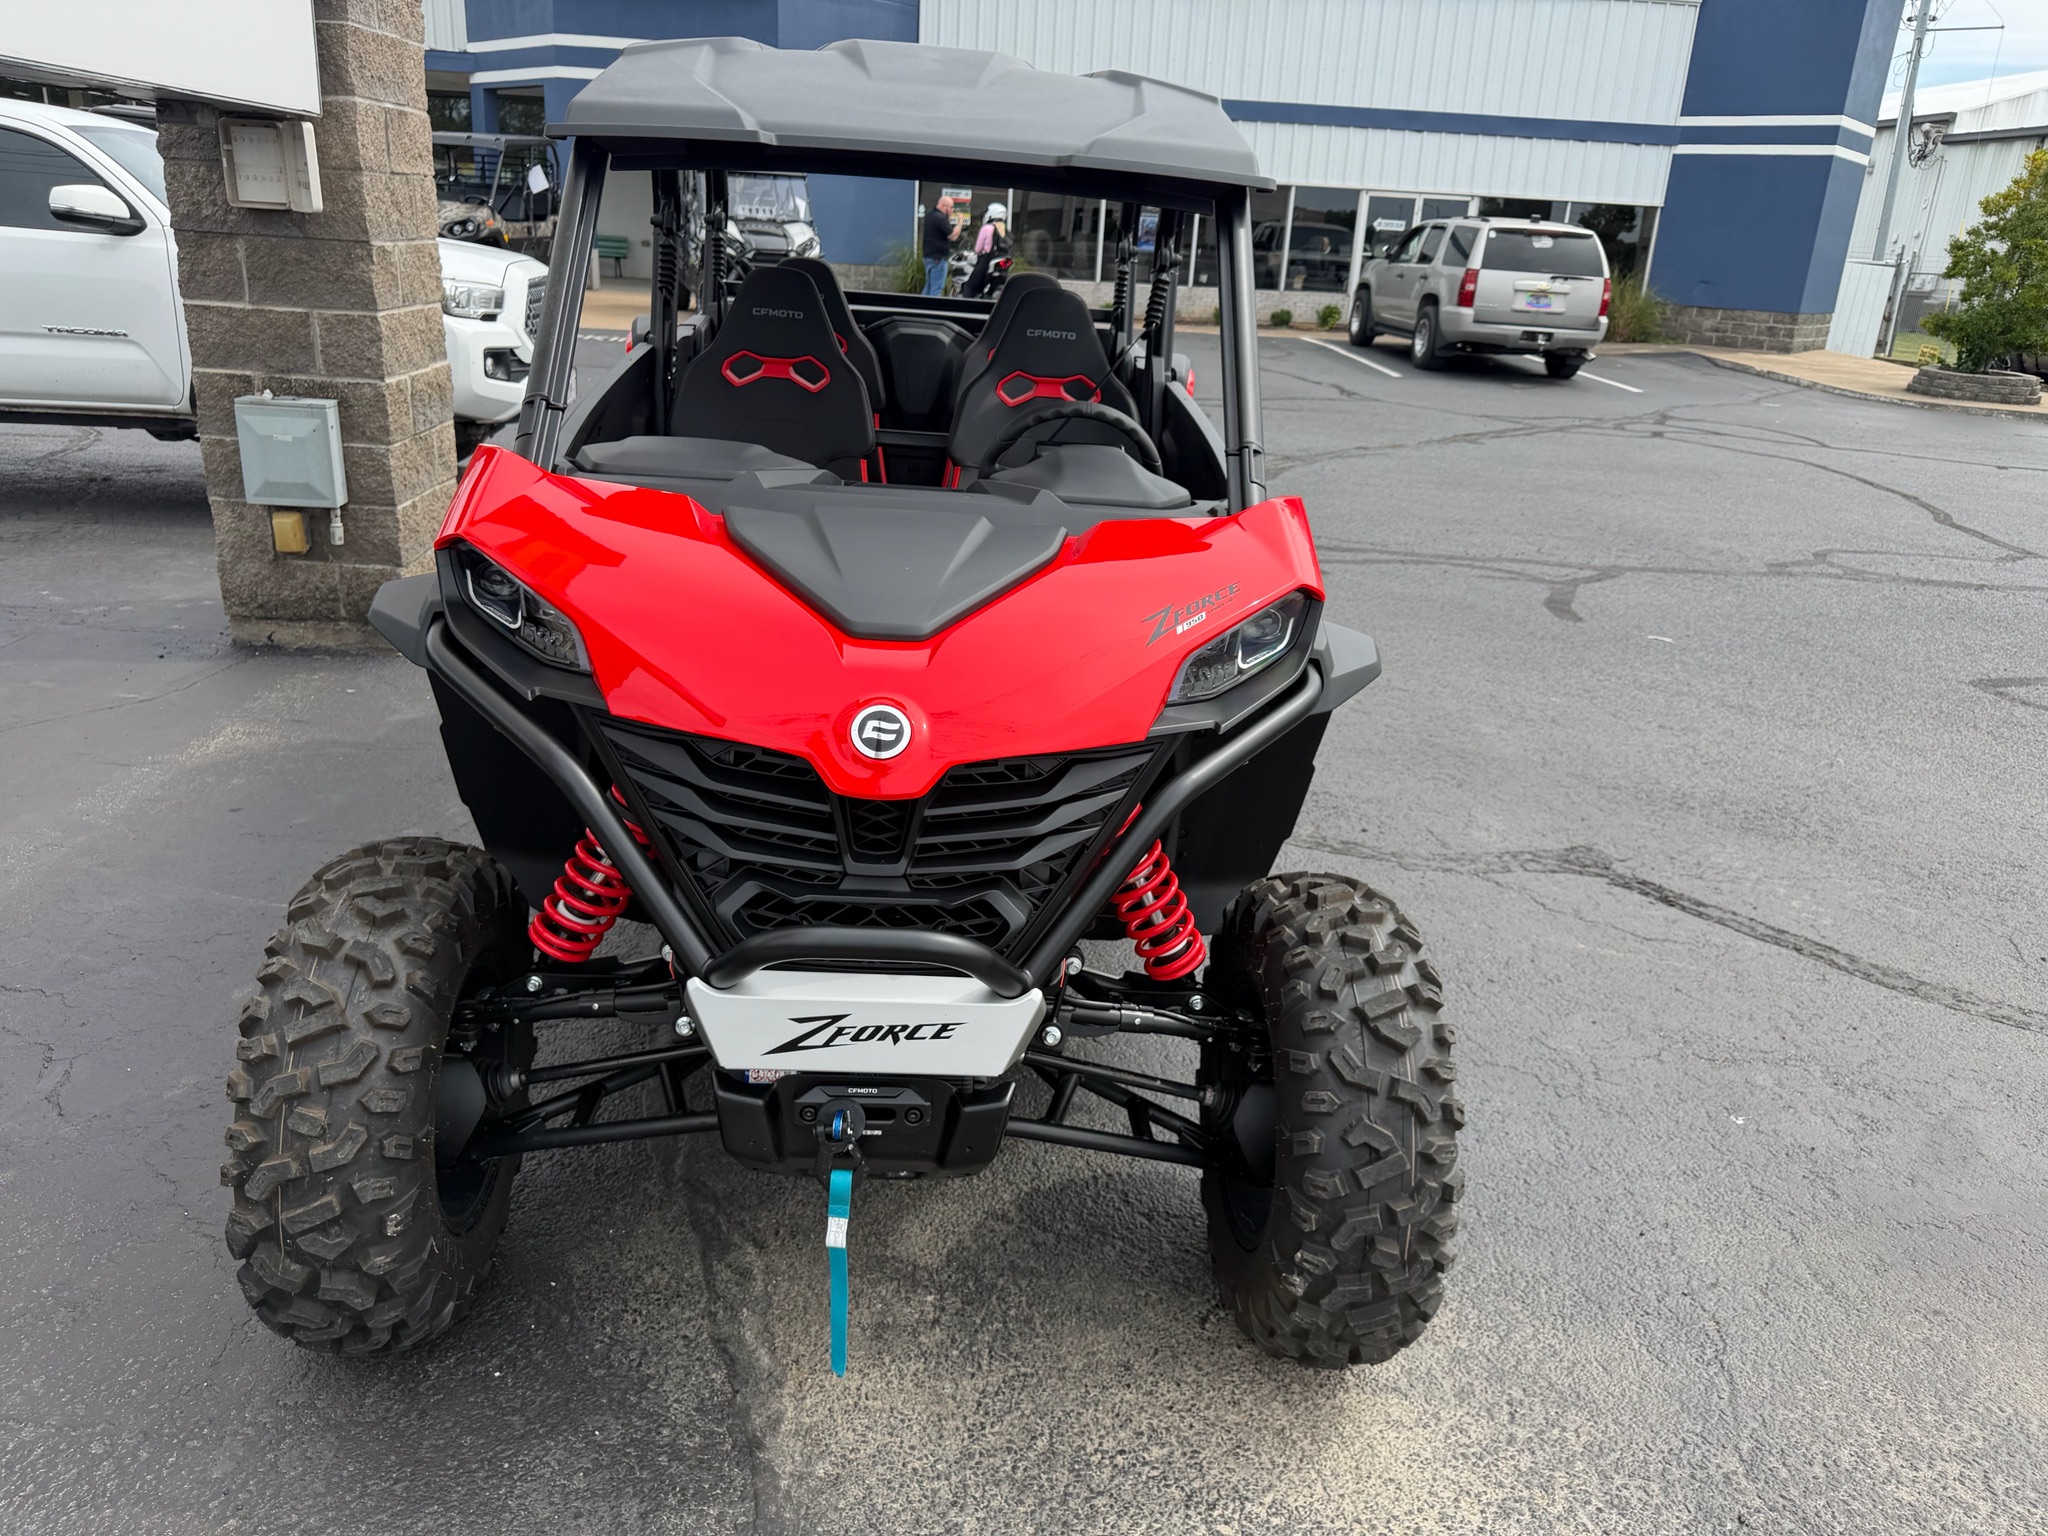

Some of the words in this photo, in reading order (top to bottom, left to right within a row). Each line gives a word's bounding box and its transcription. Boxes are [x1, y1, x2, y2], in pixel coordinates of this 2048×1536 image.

[752, 307, 804, 320] CFMOTO
[41, 324, 128, 338] TACOMA
[1026, 328, 1077, 340] CFMOTO
